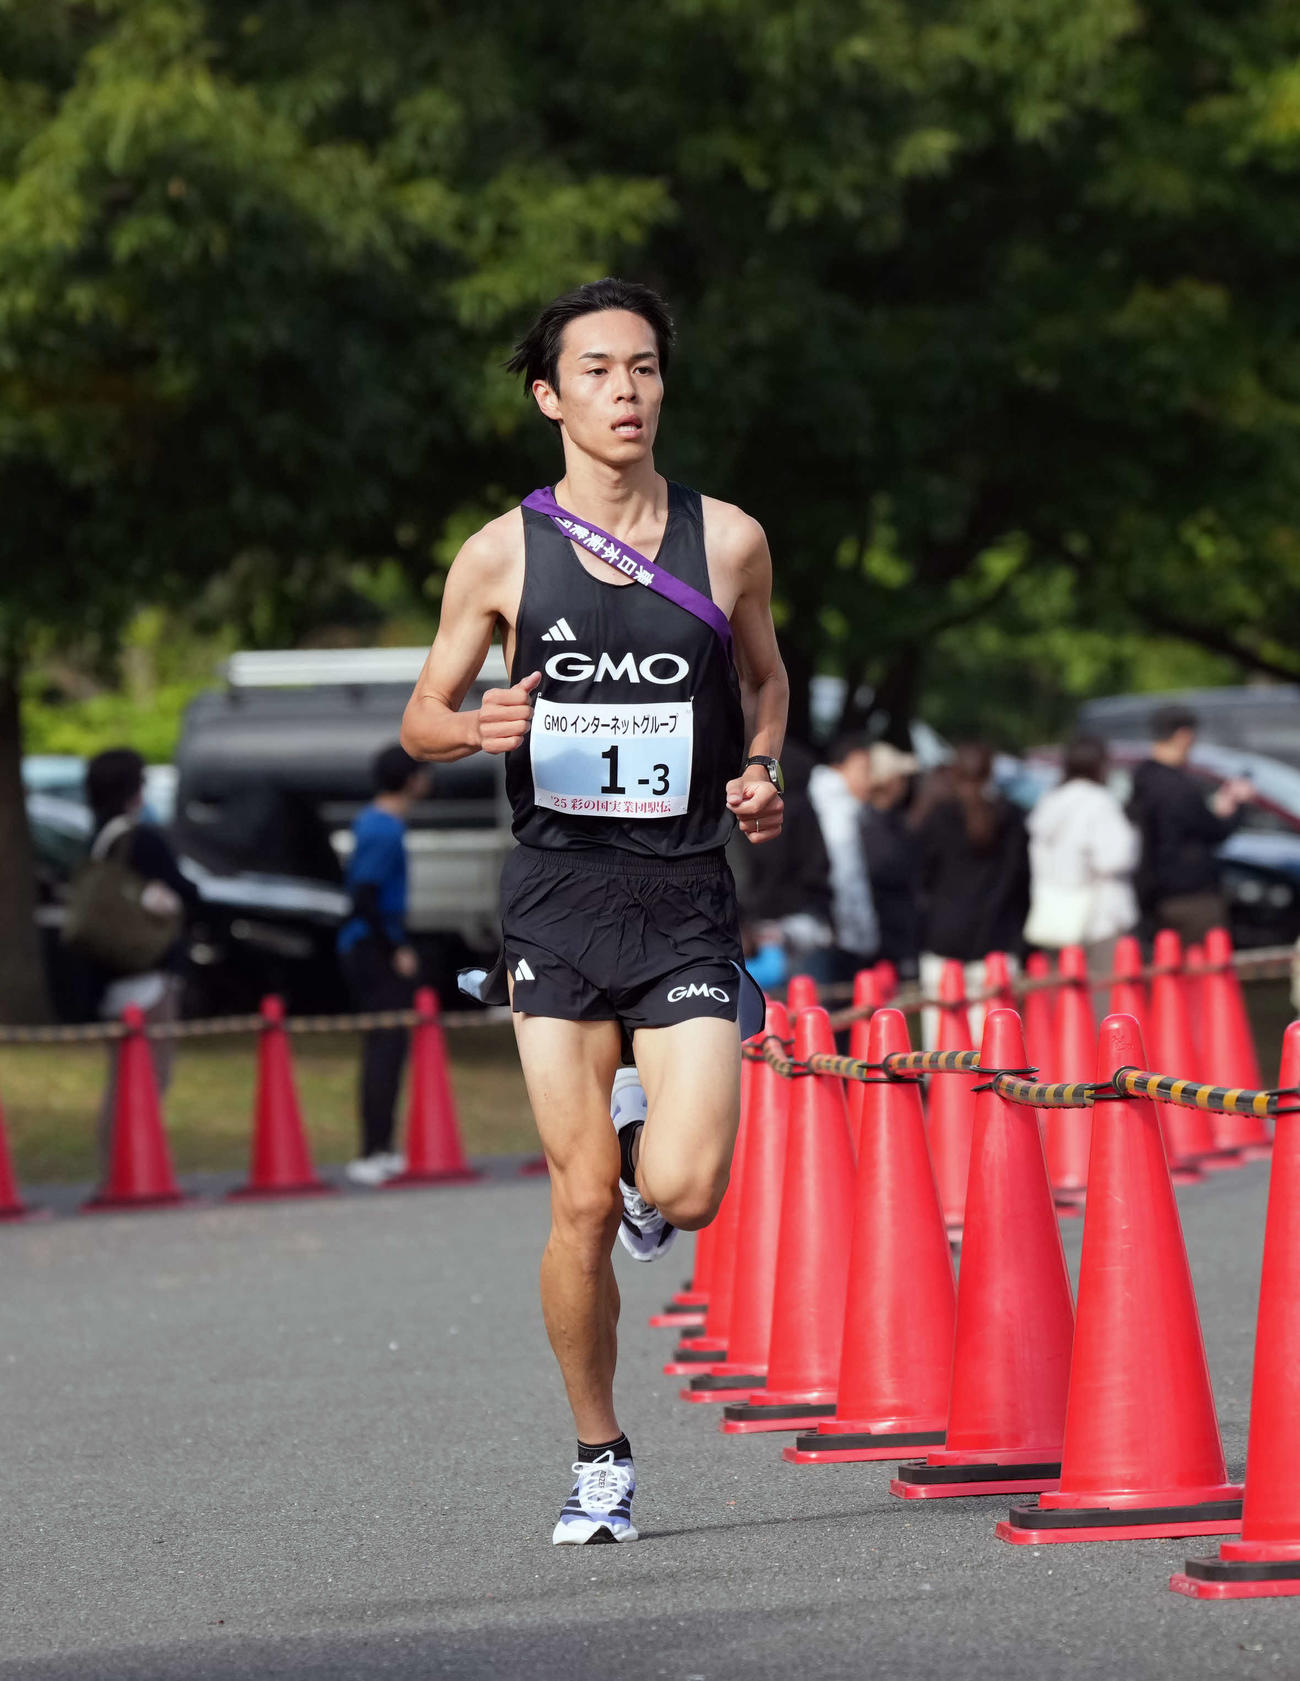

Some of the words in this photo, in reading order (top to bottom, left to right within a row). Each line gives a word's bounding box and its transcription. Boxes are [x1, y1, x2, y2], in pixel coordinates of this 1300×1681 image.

[545, 652, 690, 685] GMO
[544, 714, 568, 732] GMO
[571, 713, 679, 735] インターネットグループ
[600, 745, 626, 795] 1
[571, 798, 672, 813] 彩の国実業団駅伝
[667, 983, 730, 1003] GMO
